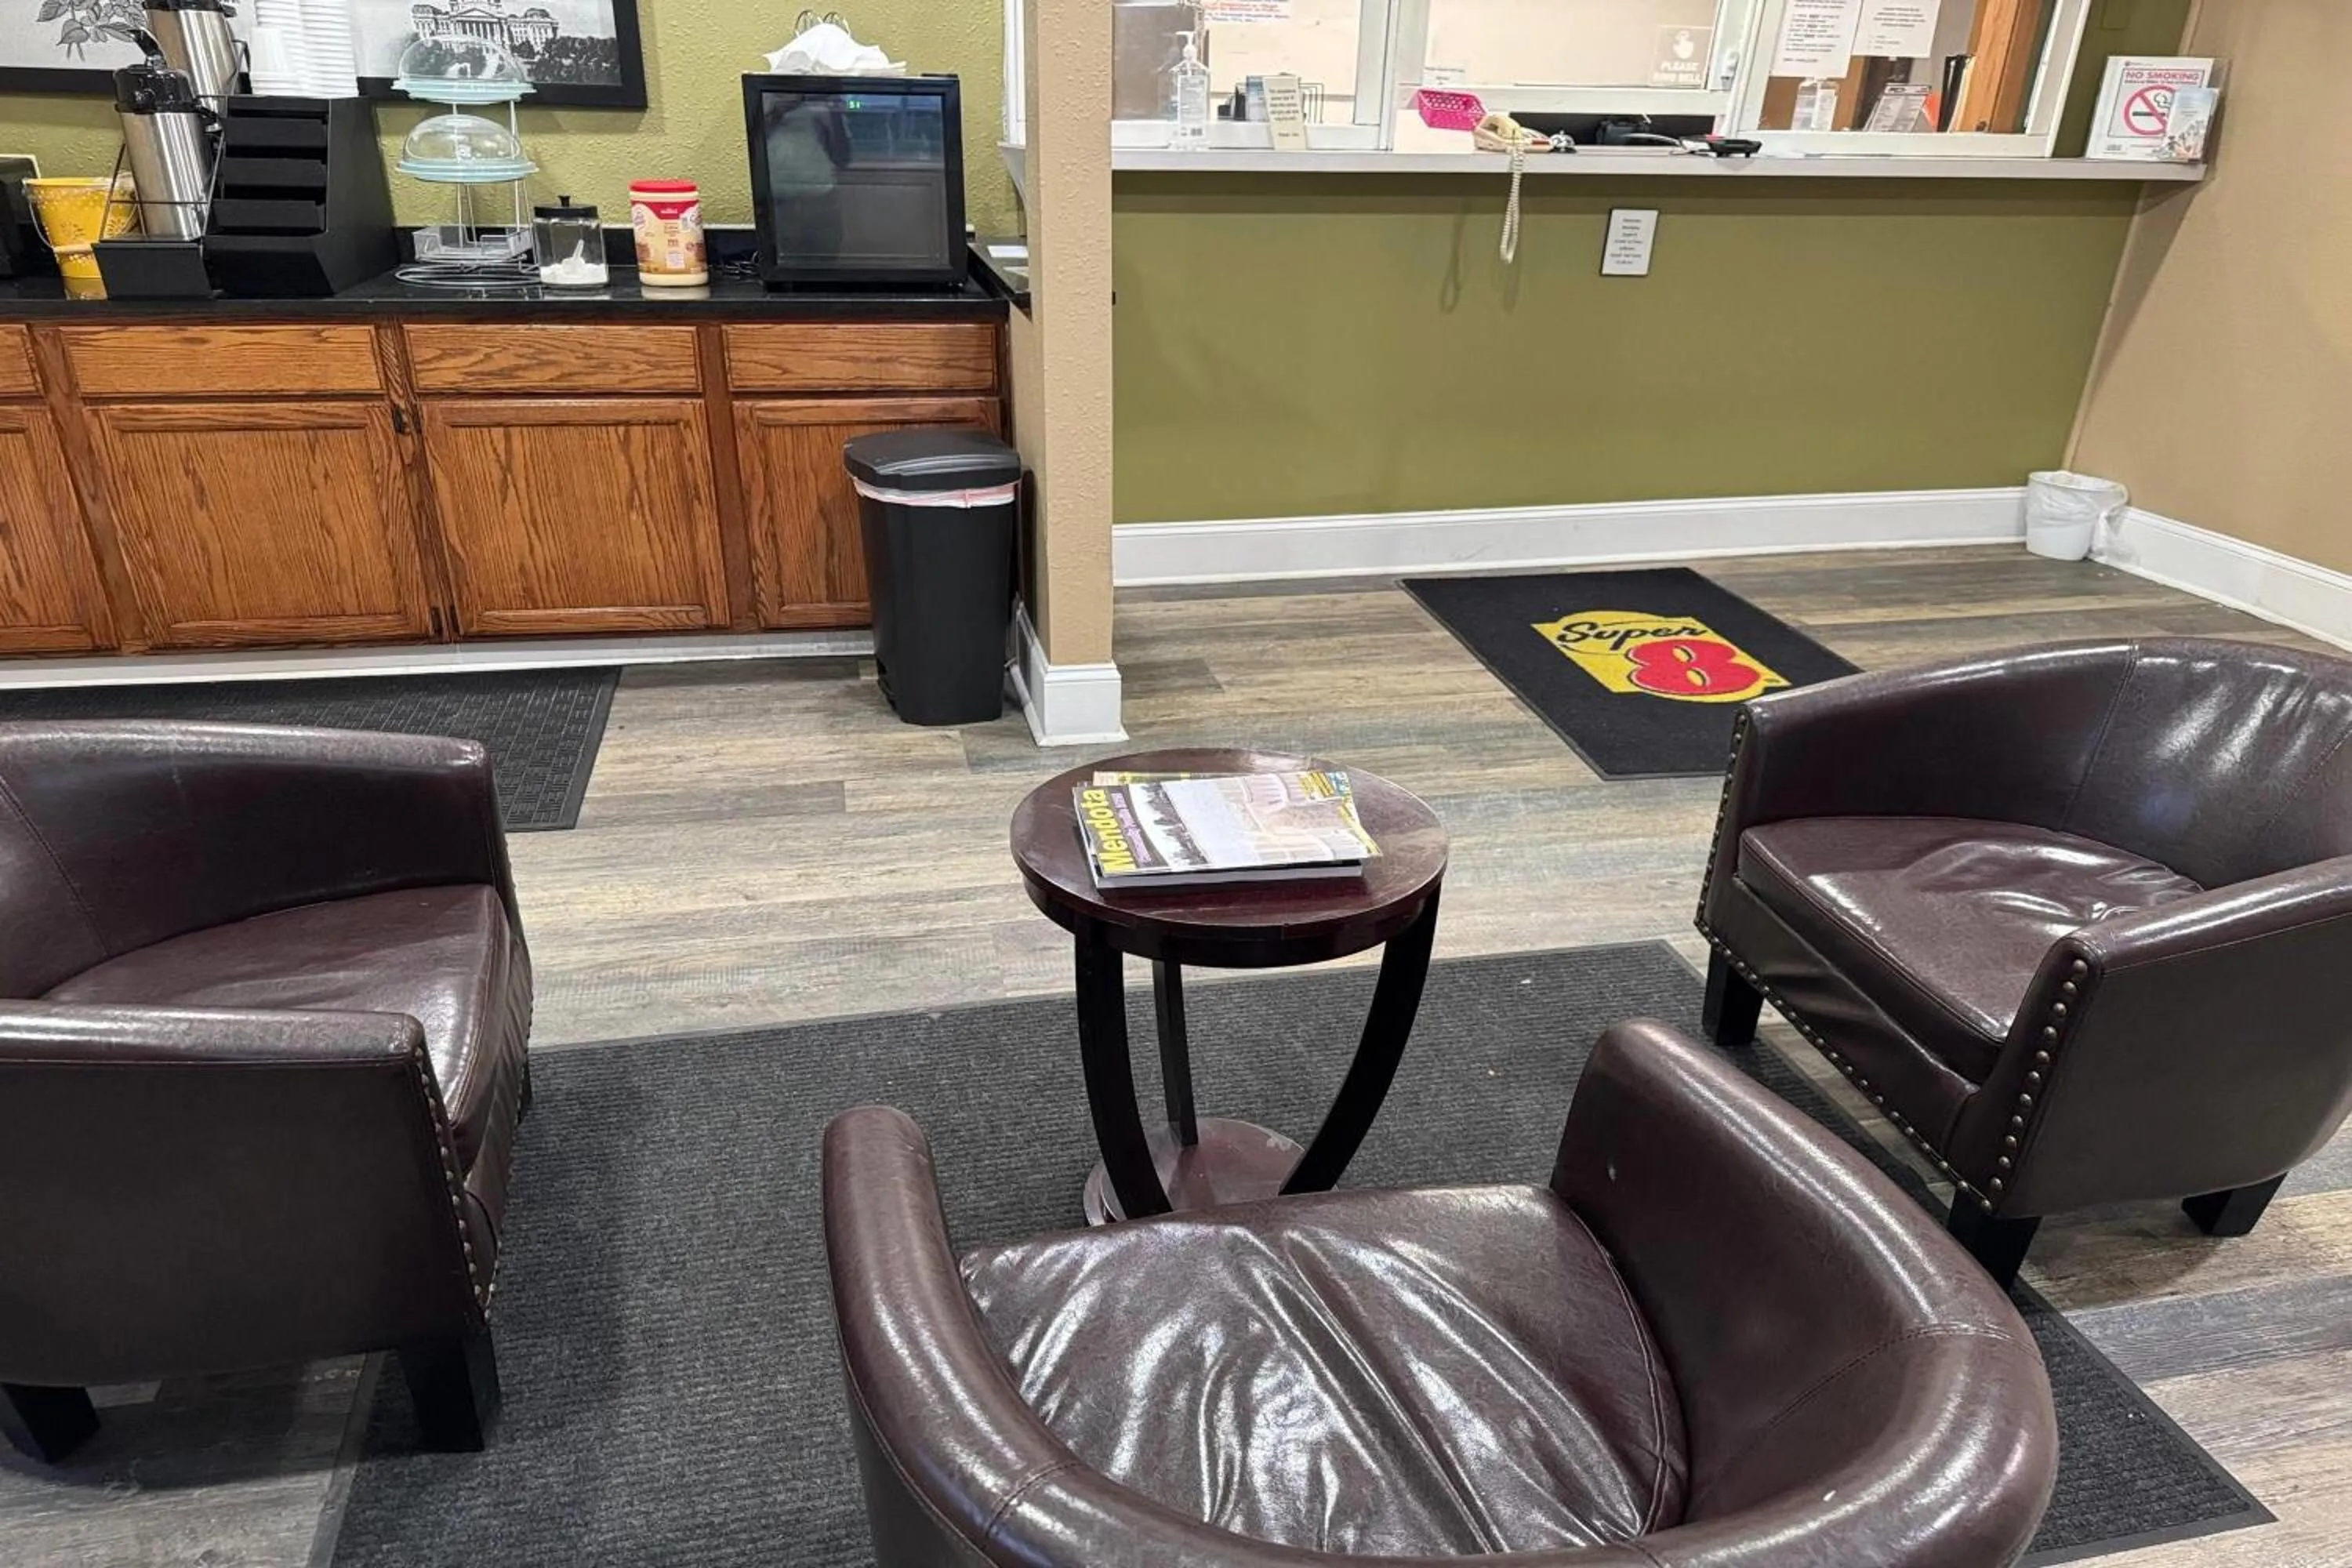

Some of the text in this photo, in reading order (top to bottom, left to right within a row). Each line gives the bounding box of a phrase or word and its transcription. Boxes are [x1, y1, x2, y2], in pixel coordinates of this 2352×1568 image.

[2147, 71, 2200, 80] SMOKING
[1555, 622, 1708, 652] Super
[1080, 789, 1138, 873] Mendota
